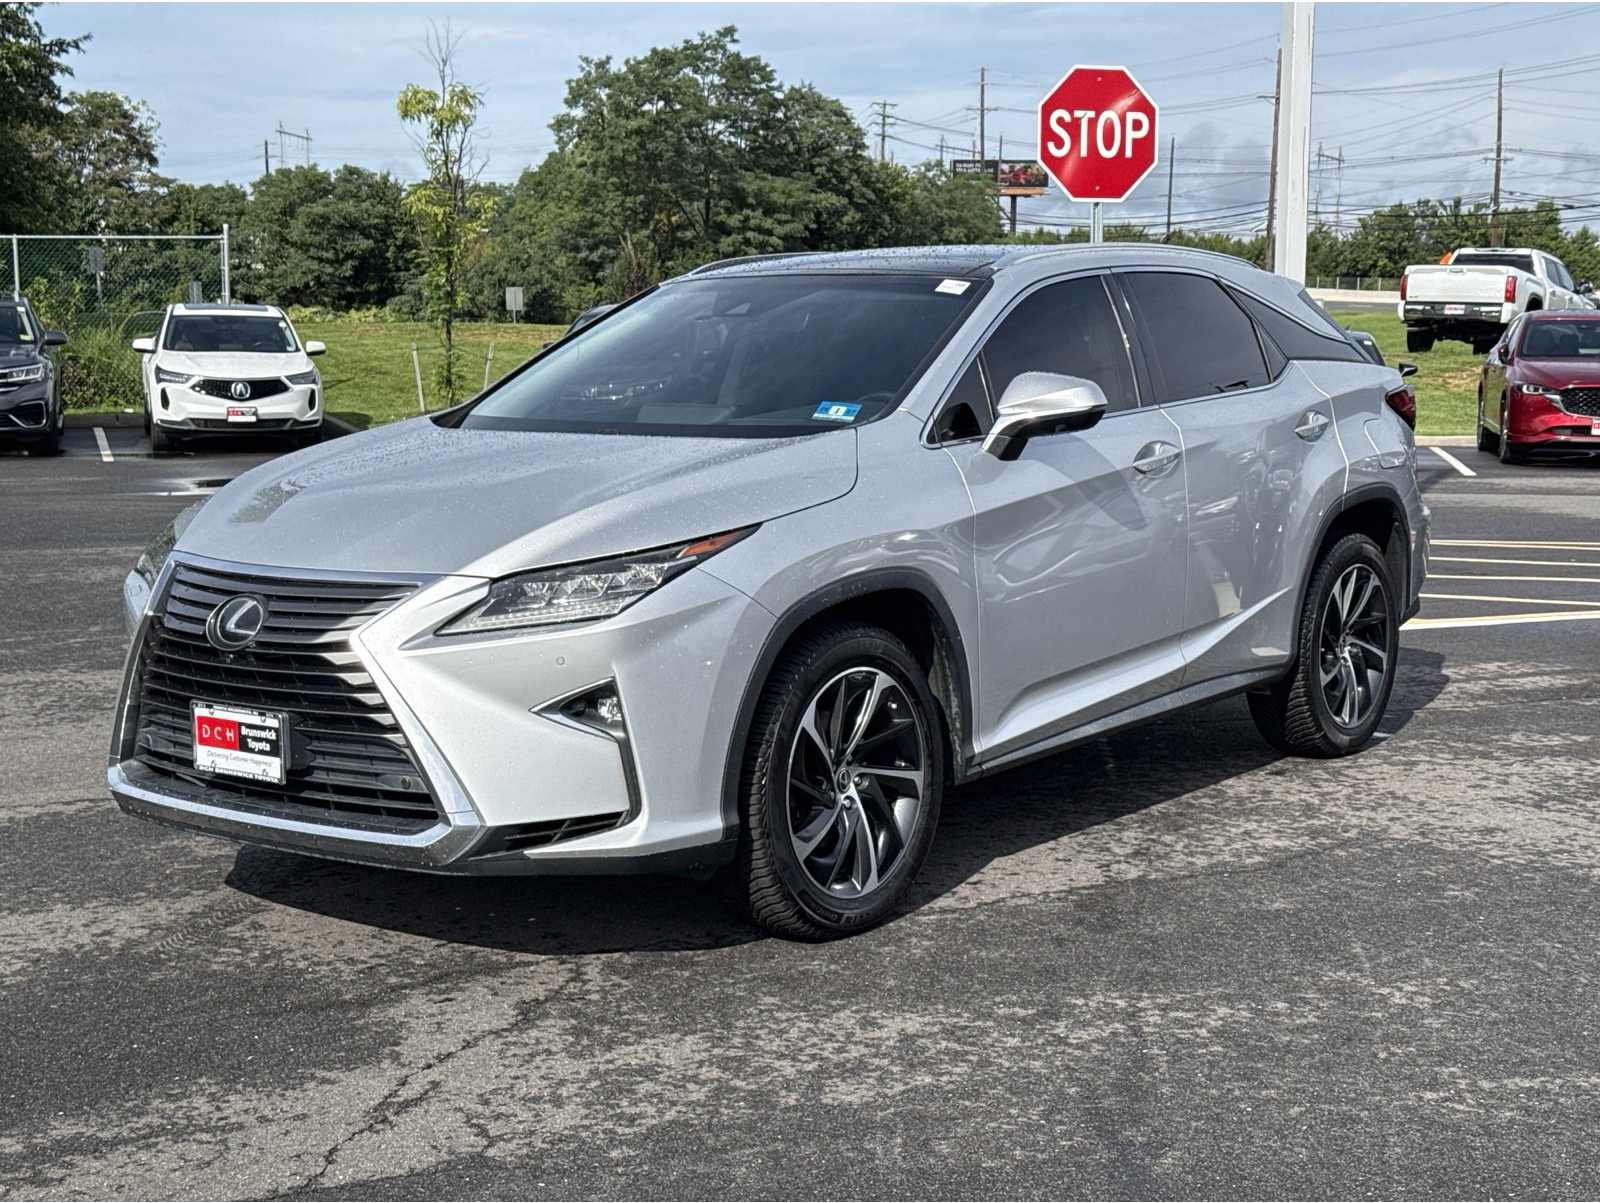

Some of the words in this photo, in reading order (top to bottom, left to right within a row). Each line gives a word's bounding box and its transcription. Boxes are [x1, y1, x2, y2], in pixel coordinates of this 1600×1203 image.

[1047, 108, 1150, 159] STOP
[202, 724, 235, 742] DCH
[240, 725, 277, 740] Brunswick
[246, 738, 271, 752] Toyota
